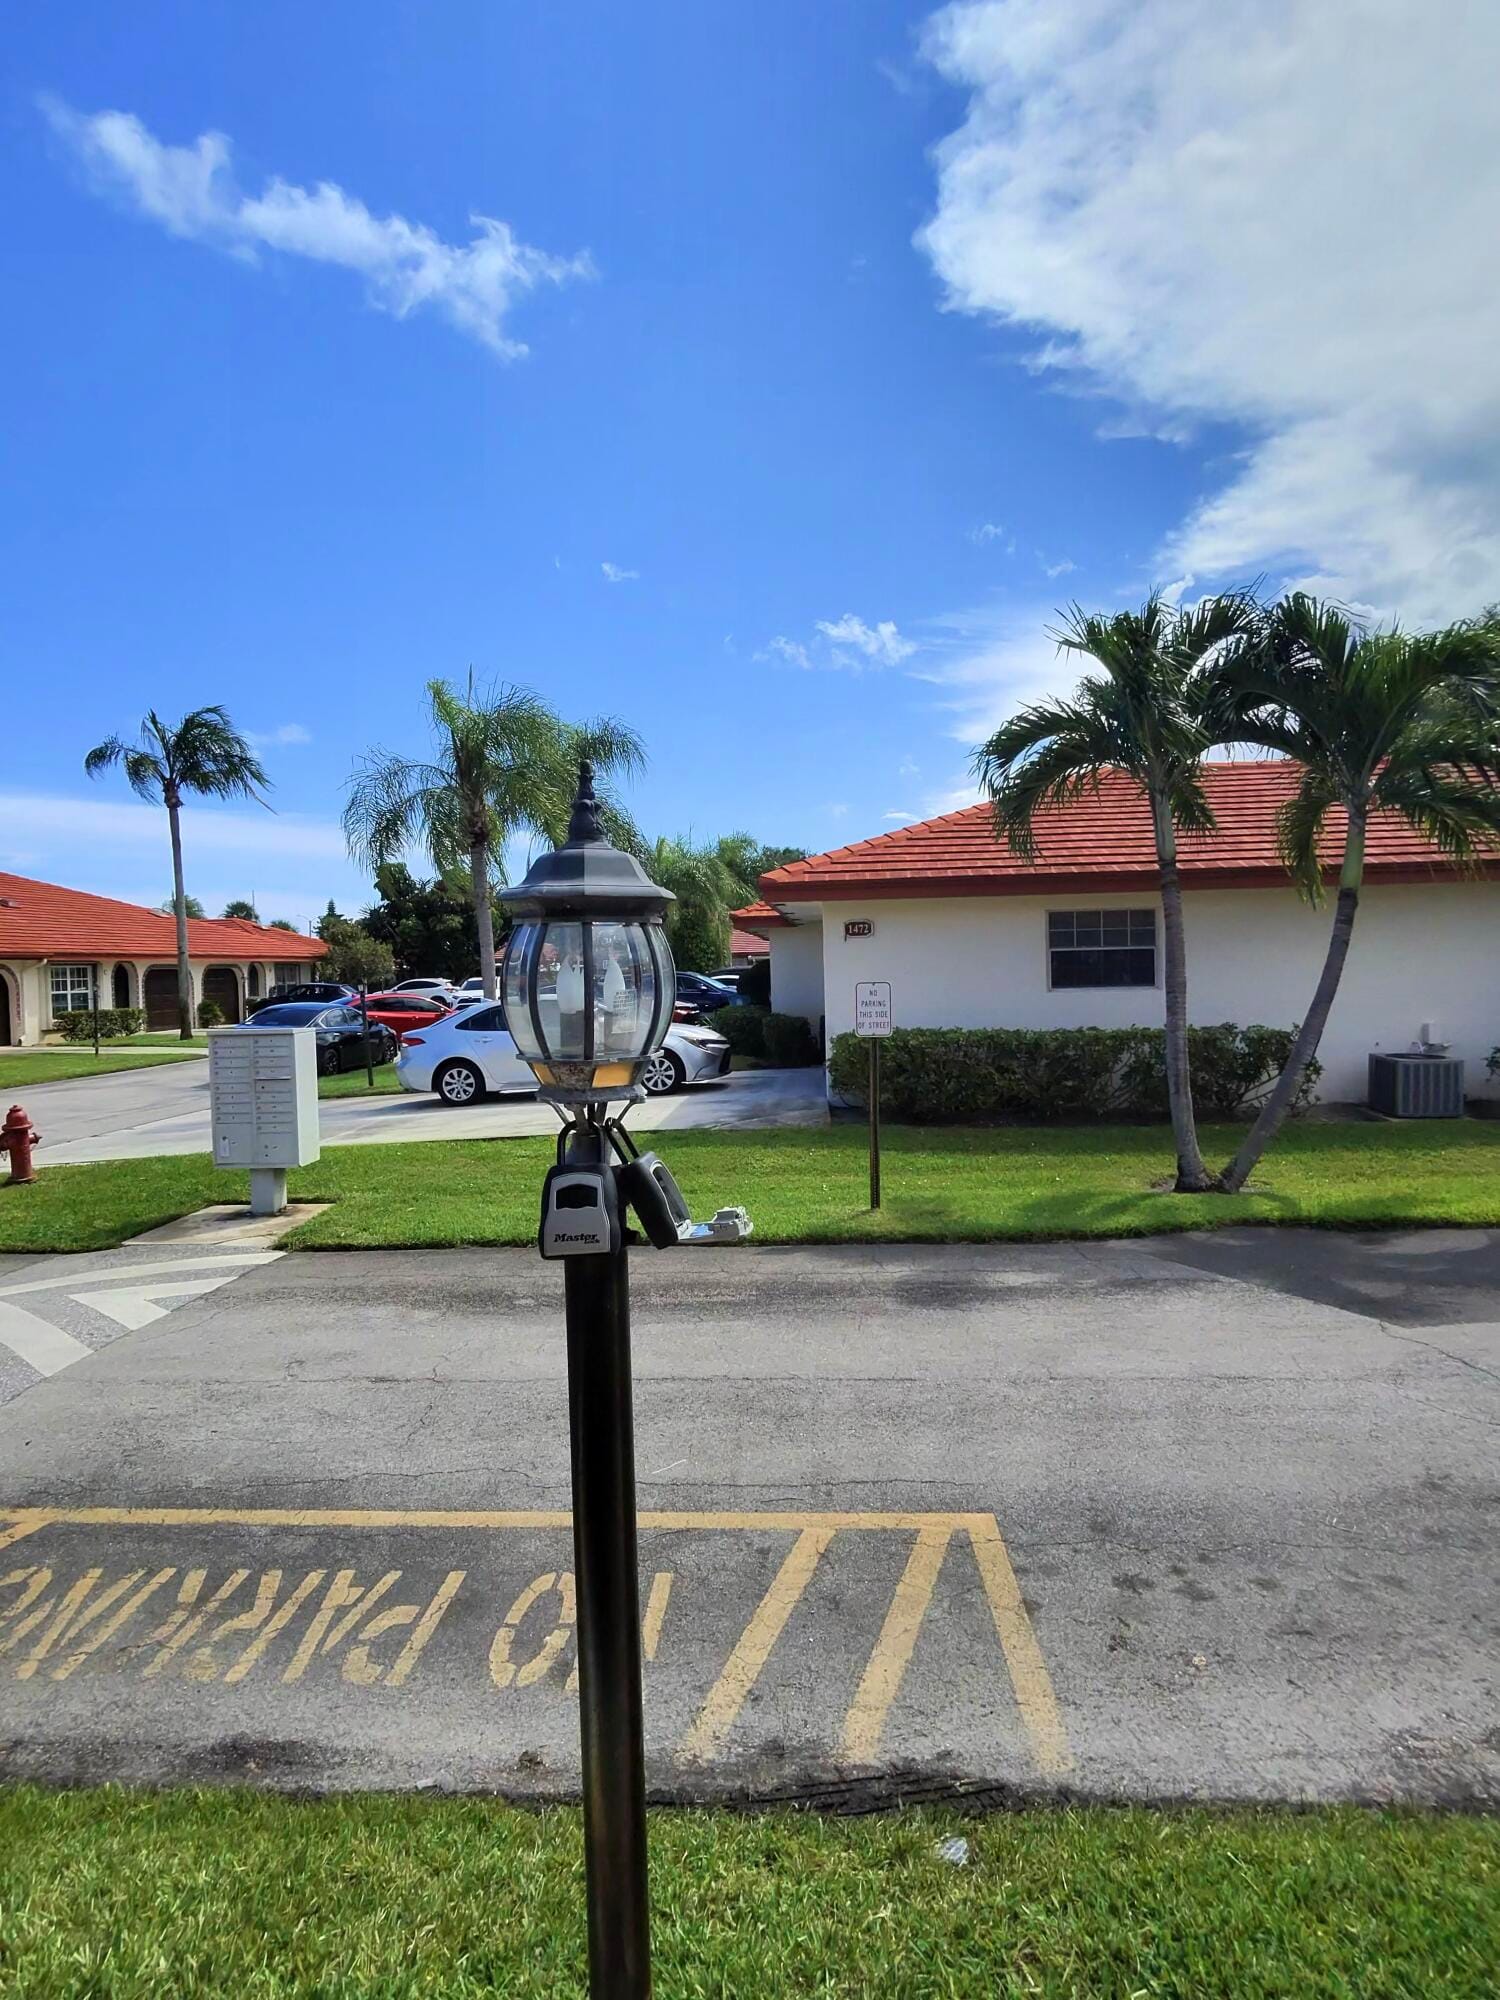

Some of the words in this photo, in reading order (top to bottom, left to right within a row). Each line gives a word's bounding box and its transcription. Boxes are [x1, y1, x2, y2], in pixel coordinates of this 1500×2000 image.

[848, 924, 870, 934] 1472
[860, 1000, 887, 1008] PARKING
[858, 1021, 865, 1029] OF
[868, 1021, 889, 1029] STREET
[554, 1233, 598, 1243] Master
